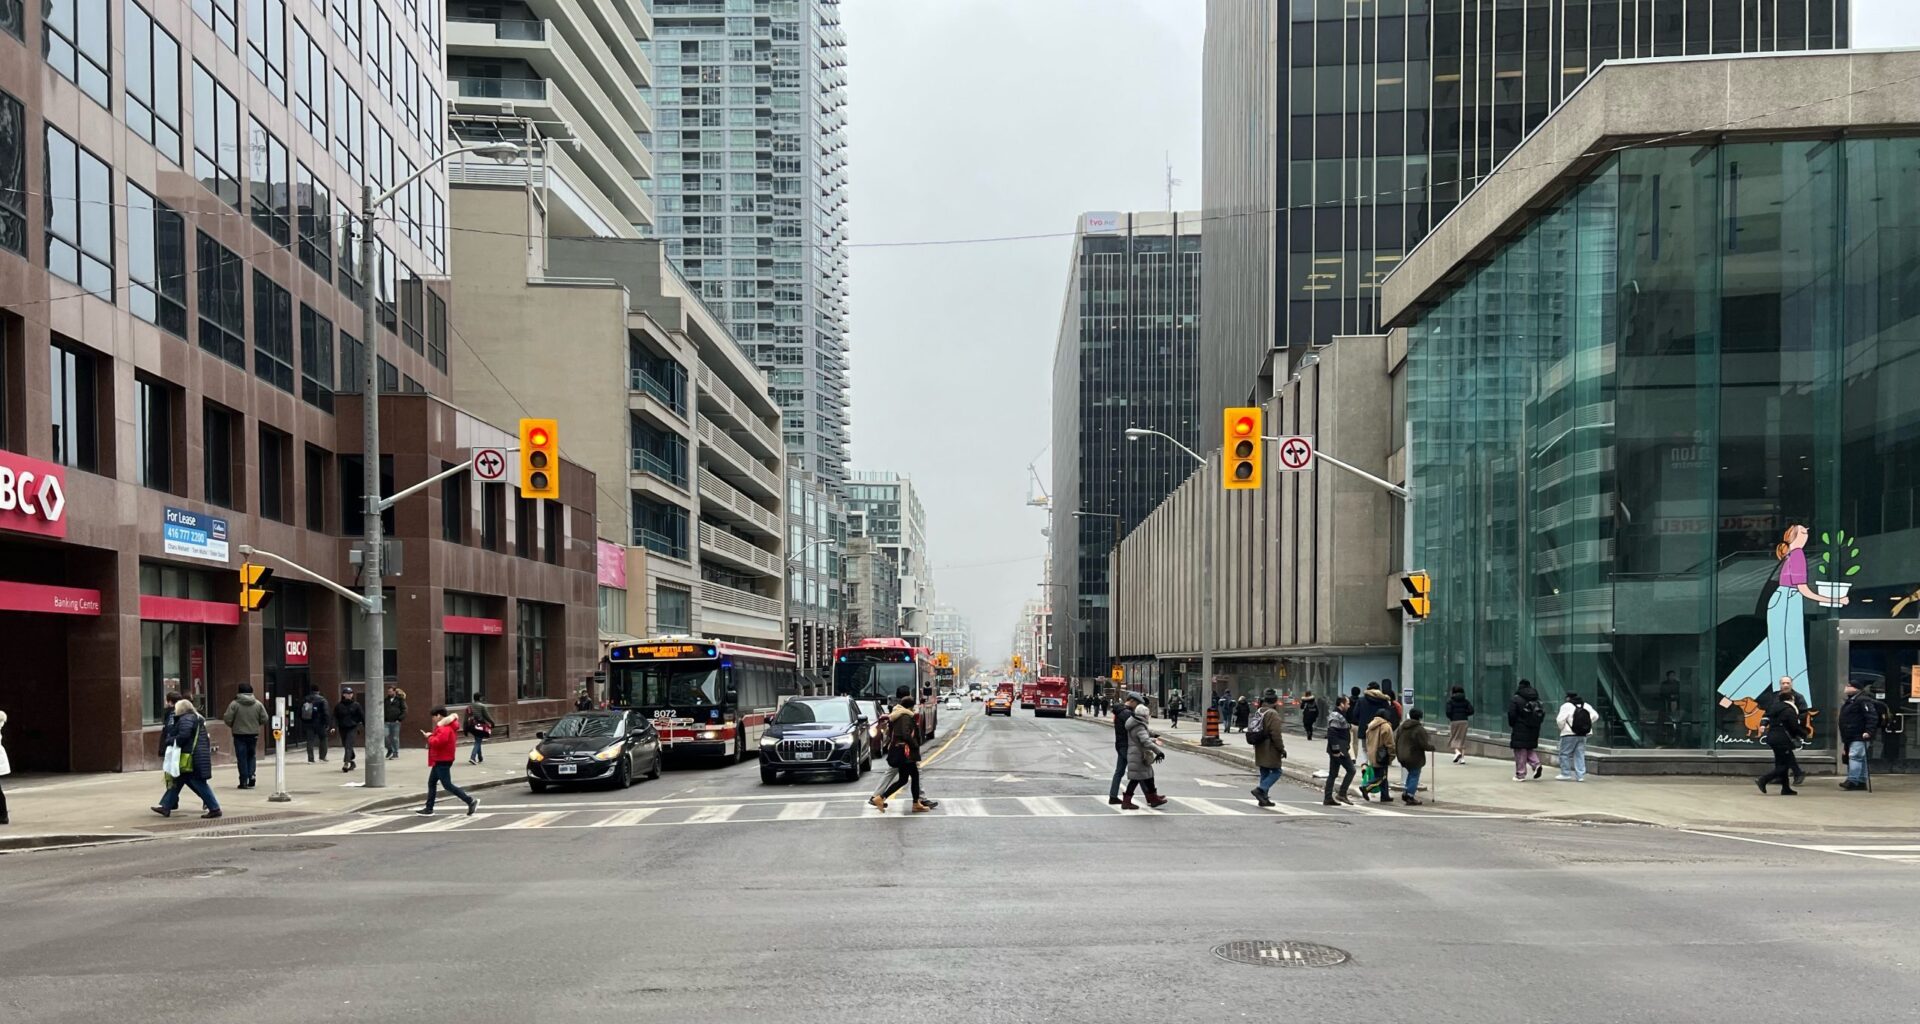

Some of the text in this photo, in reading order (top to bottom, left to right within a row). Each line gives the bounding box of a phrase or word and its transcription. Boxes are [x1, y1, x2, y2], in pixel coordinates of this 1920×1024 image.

[167, 509, 196, 526] For Lease
[168, 527, 205, 544] 416 777 2200
[54, 595, 99, 611] Banking Centre
[286, 641, 301, 656] CIBC
[629, 647, 634, 658] 1
[654, 709, 677, 718] 8072
